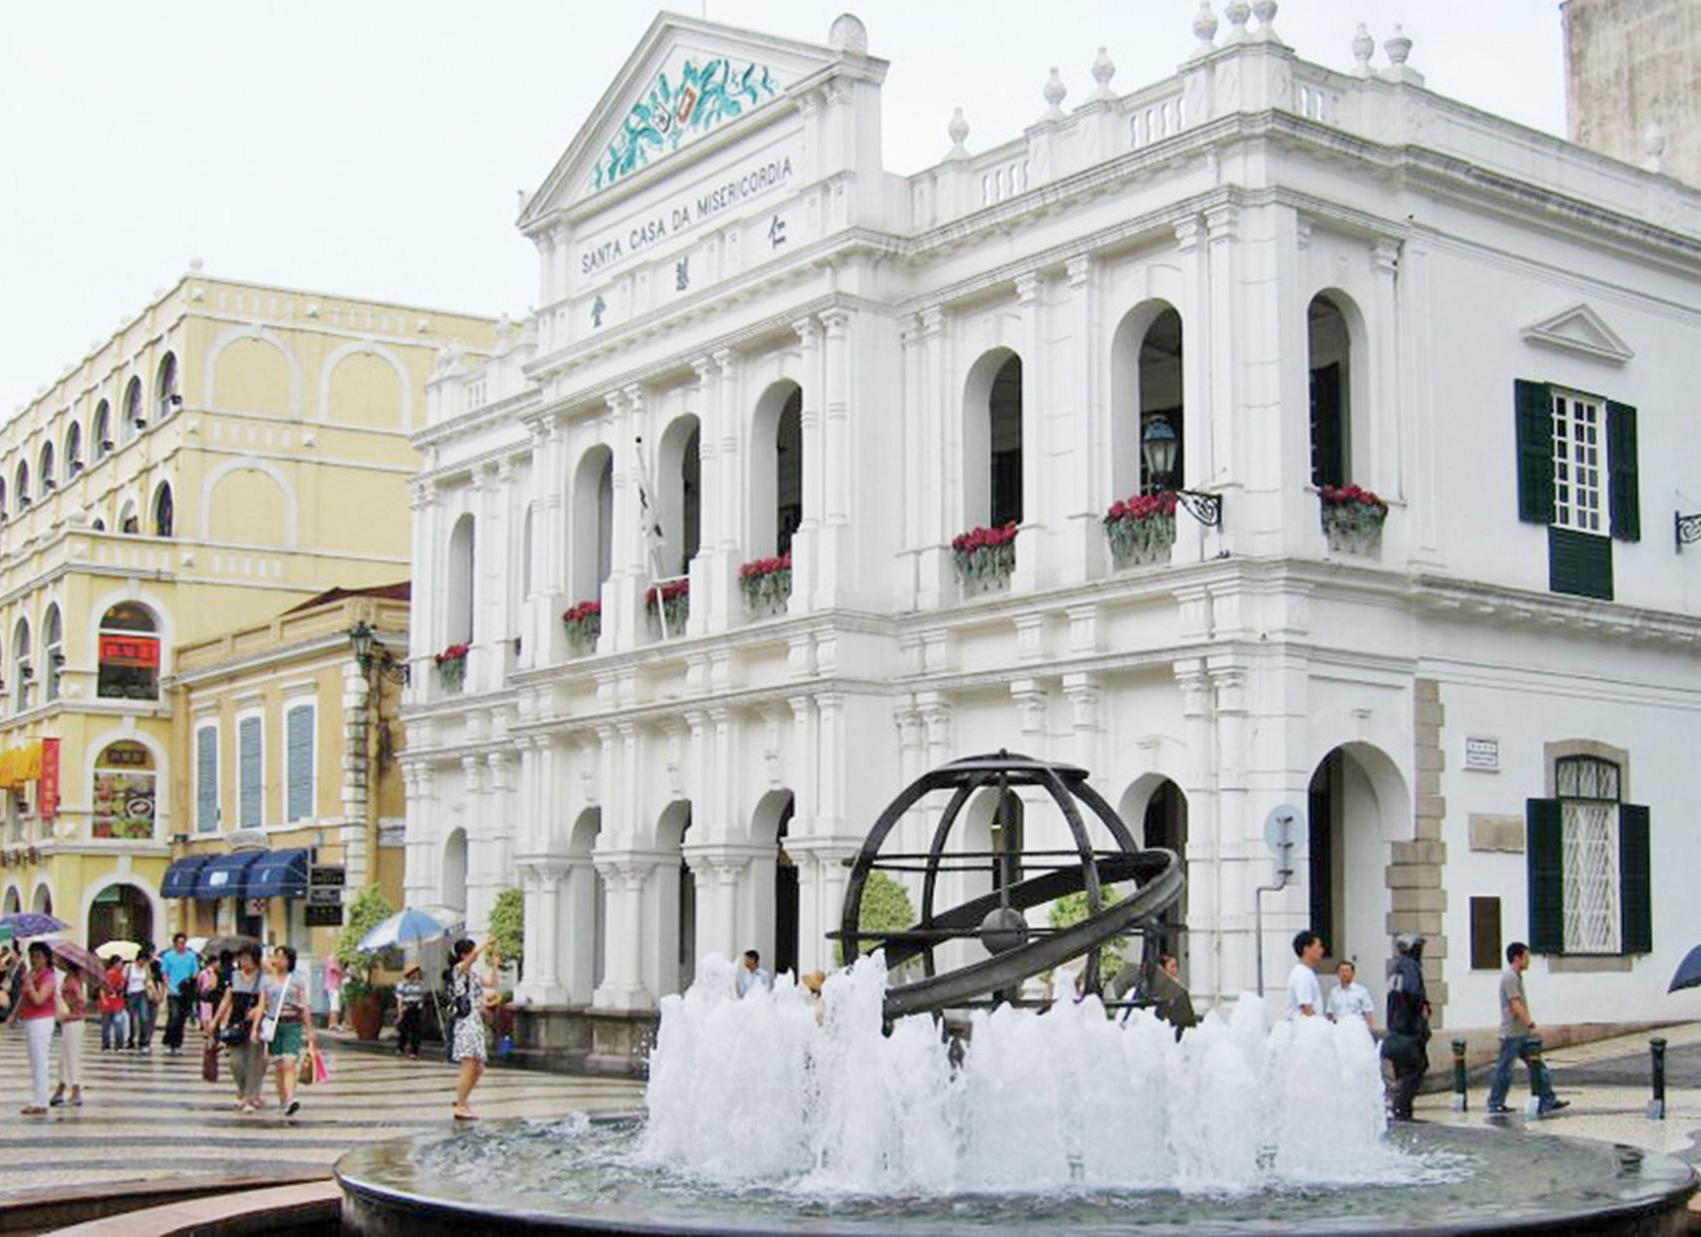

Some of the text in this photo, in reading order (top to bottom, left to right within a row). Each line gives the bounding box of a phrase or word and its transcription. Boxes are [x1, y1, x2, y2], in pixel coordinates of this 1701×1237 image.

[581, 157, 793, 274] SANTA CASA DA MISERICORDIA
